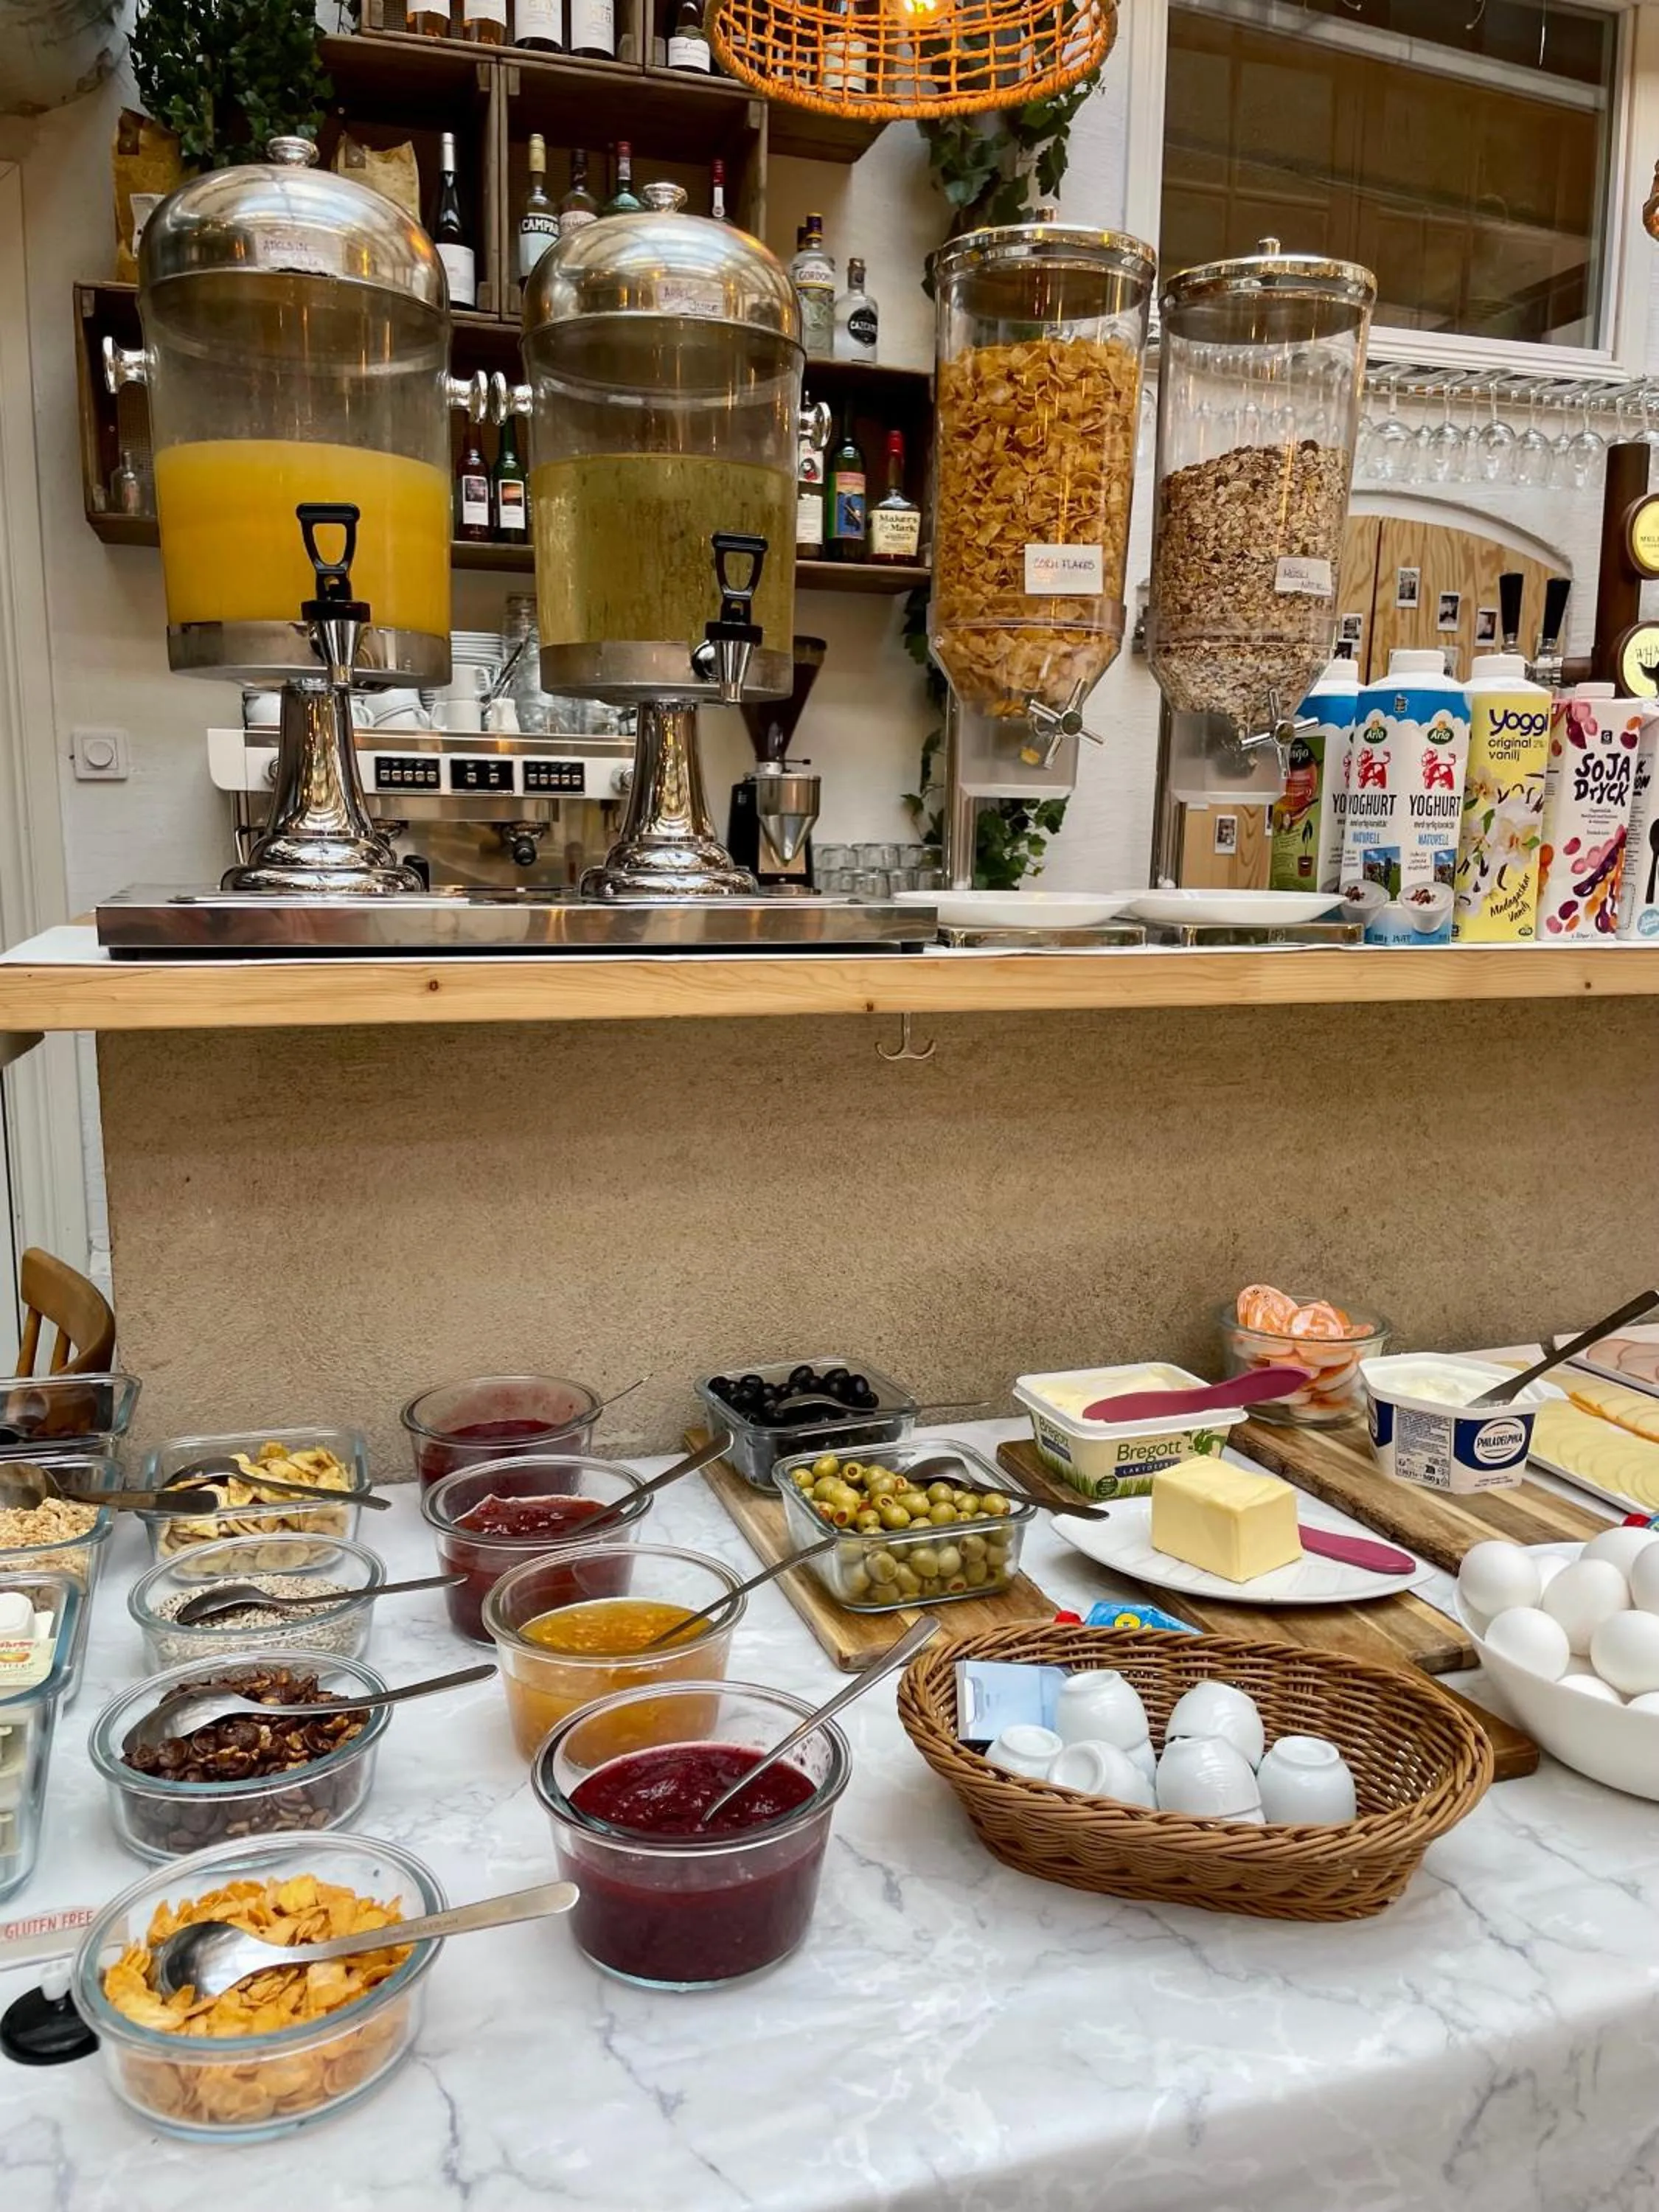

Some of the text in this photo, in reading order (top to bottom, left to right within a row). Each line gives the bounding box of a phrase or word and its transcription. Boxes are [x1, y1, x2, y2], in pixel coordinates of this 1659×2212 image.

[1366, 728, 1384, 739] Arla
[1431, 728, 1450, 740] Arla
[1488, 737, 1531, 749] original
[1489, 750, 1520, 761] vanilj
[1348, 793, 1397, 815] YOGHURT
[1410, 794, 1461, 816] YOGHURT
[1477, 1433, 1523, 1448] PHILADELPHIA
[1117, 1441, 1181, 1463] Bregott
[5, 1910, 94, 1939] GLUTEN FREE
